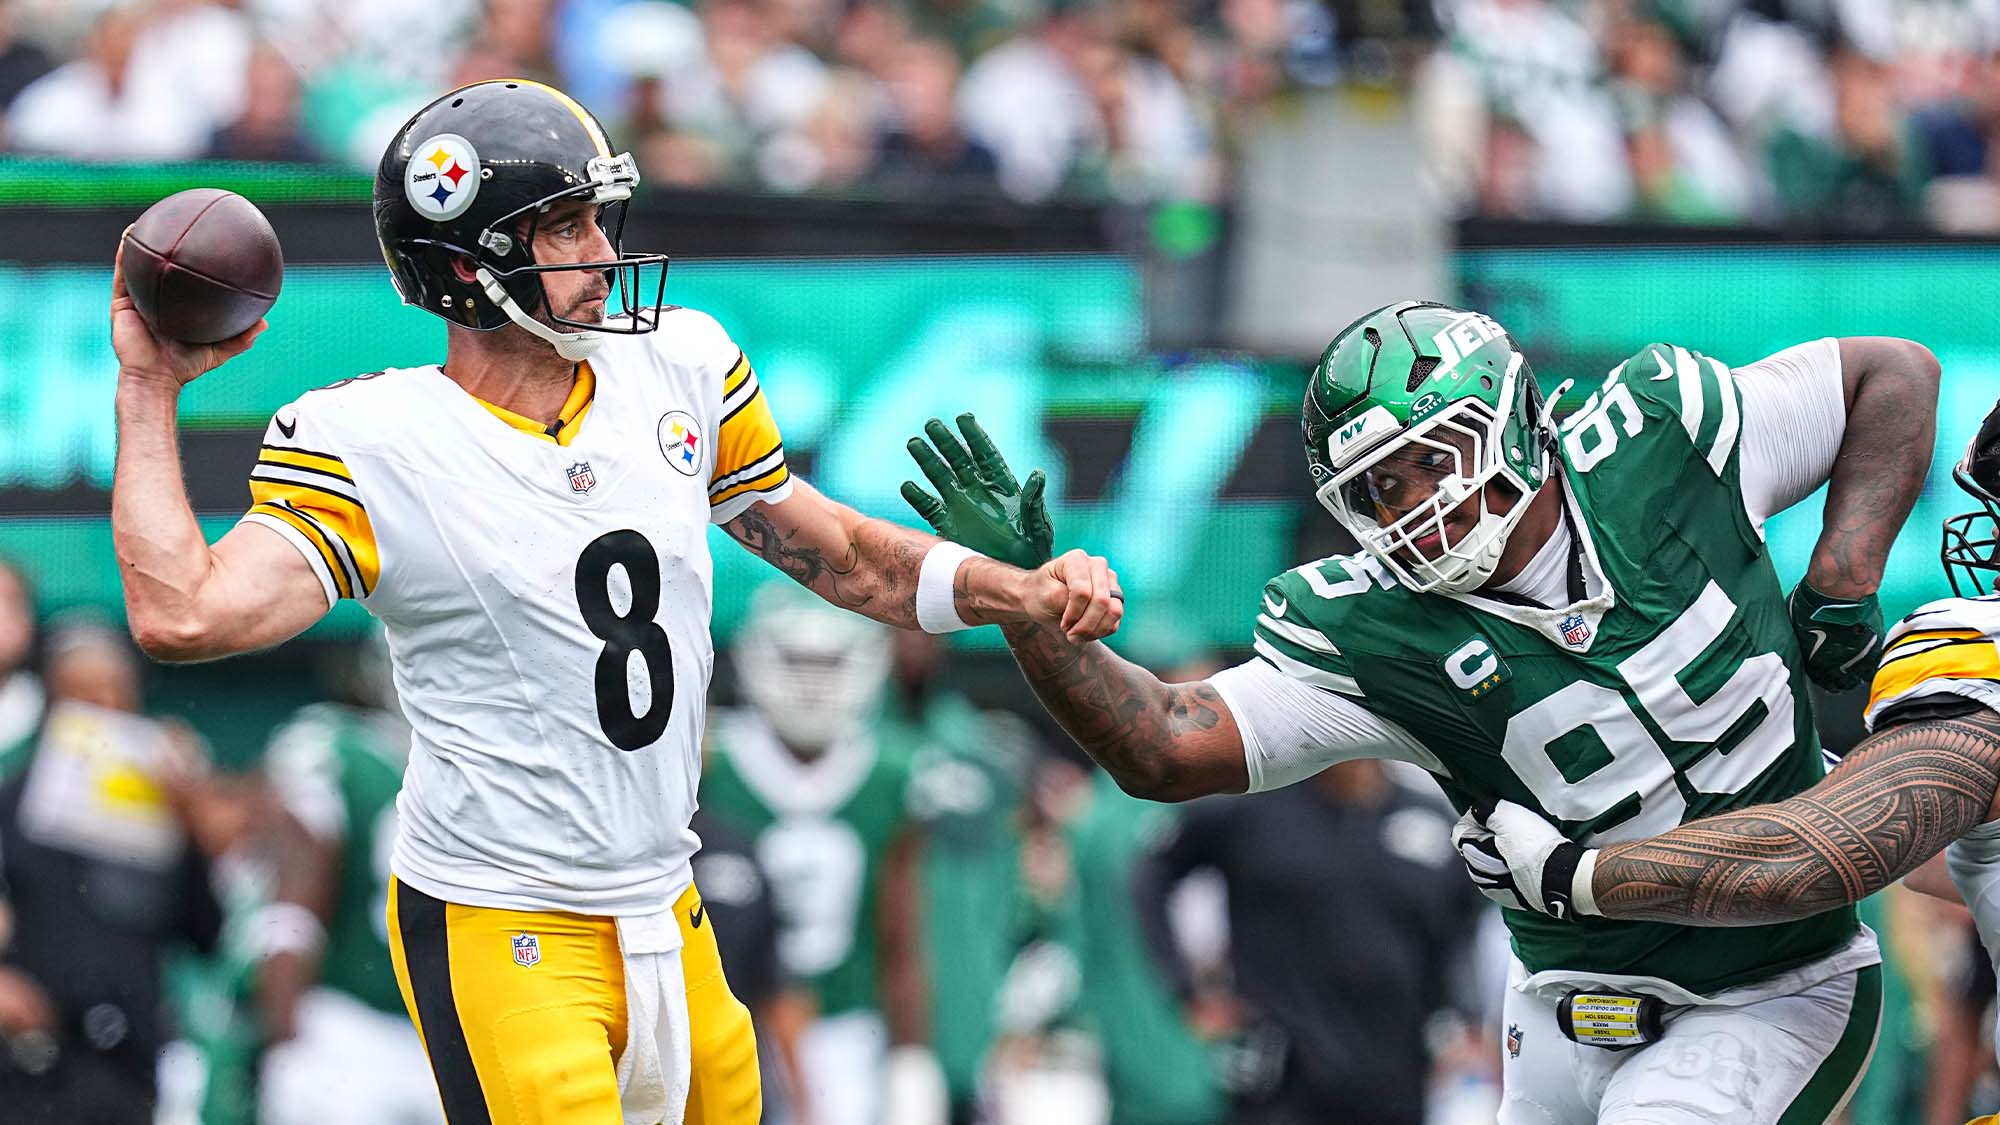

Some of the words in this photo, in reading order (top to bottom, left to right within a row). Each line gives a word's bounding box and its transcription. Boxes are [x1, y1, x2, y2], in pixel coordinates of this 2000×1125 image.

[413, 172, 436, 183] Steelers
[1432, 315, 1508, 383] JETS
[1412, 396, 1444, 421] OAKLEY
[1339, 417, 1367, 445] NY
[572, 474, 594, 491] NFL
[574, 528, 675, 752] 8
[1566, 625, 1589, 644] NFL
[1444, 639, 1499, 691] C
[1500, 578, 1797, 850] 95
[516, 948, 537, 962] NFL
